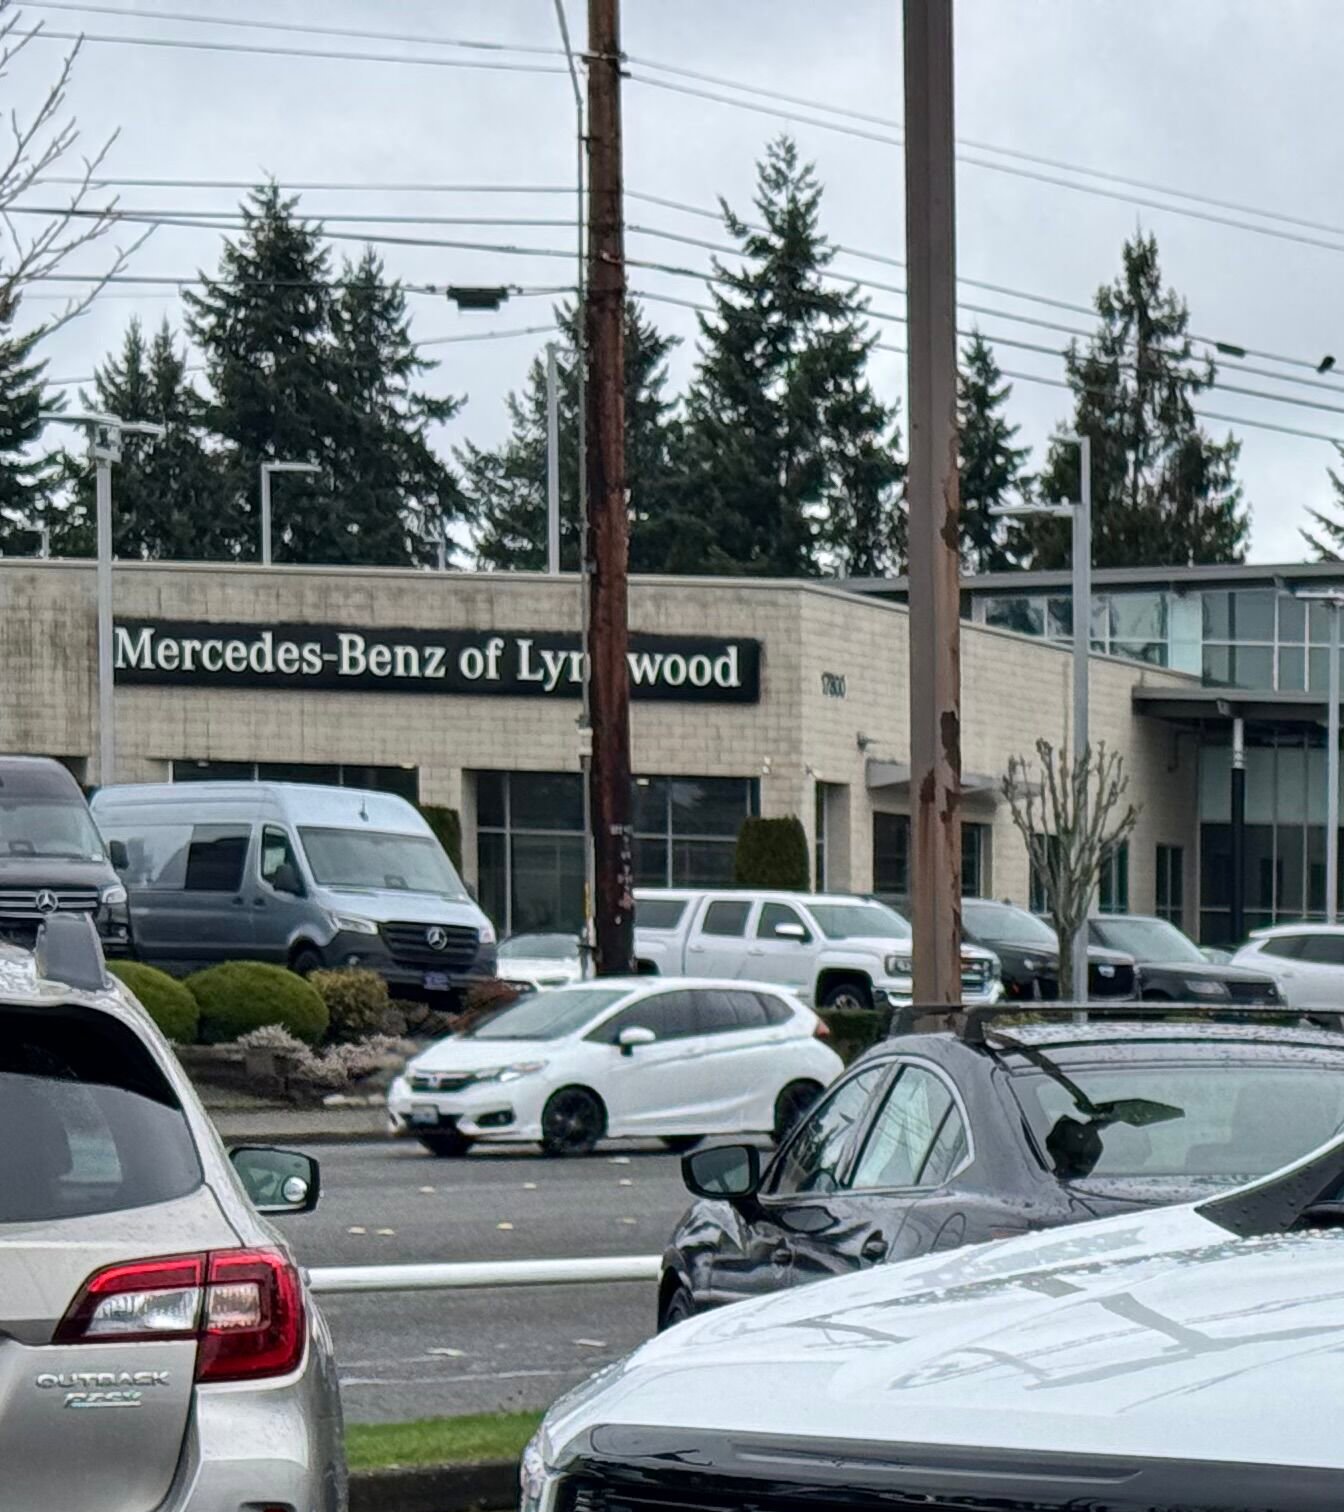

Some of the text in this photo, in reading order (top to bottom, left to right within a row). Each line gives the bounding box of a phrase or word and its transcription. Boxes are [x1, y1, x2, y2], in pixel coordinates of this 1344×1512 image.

[113, 626, 447, 679] Mercedes-Benz
[459, 637, 505, 681] of
[36, 1371, 170, 1389] OUTBACK
